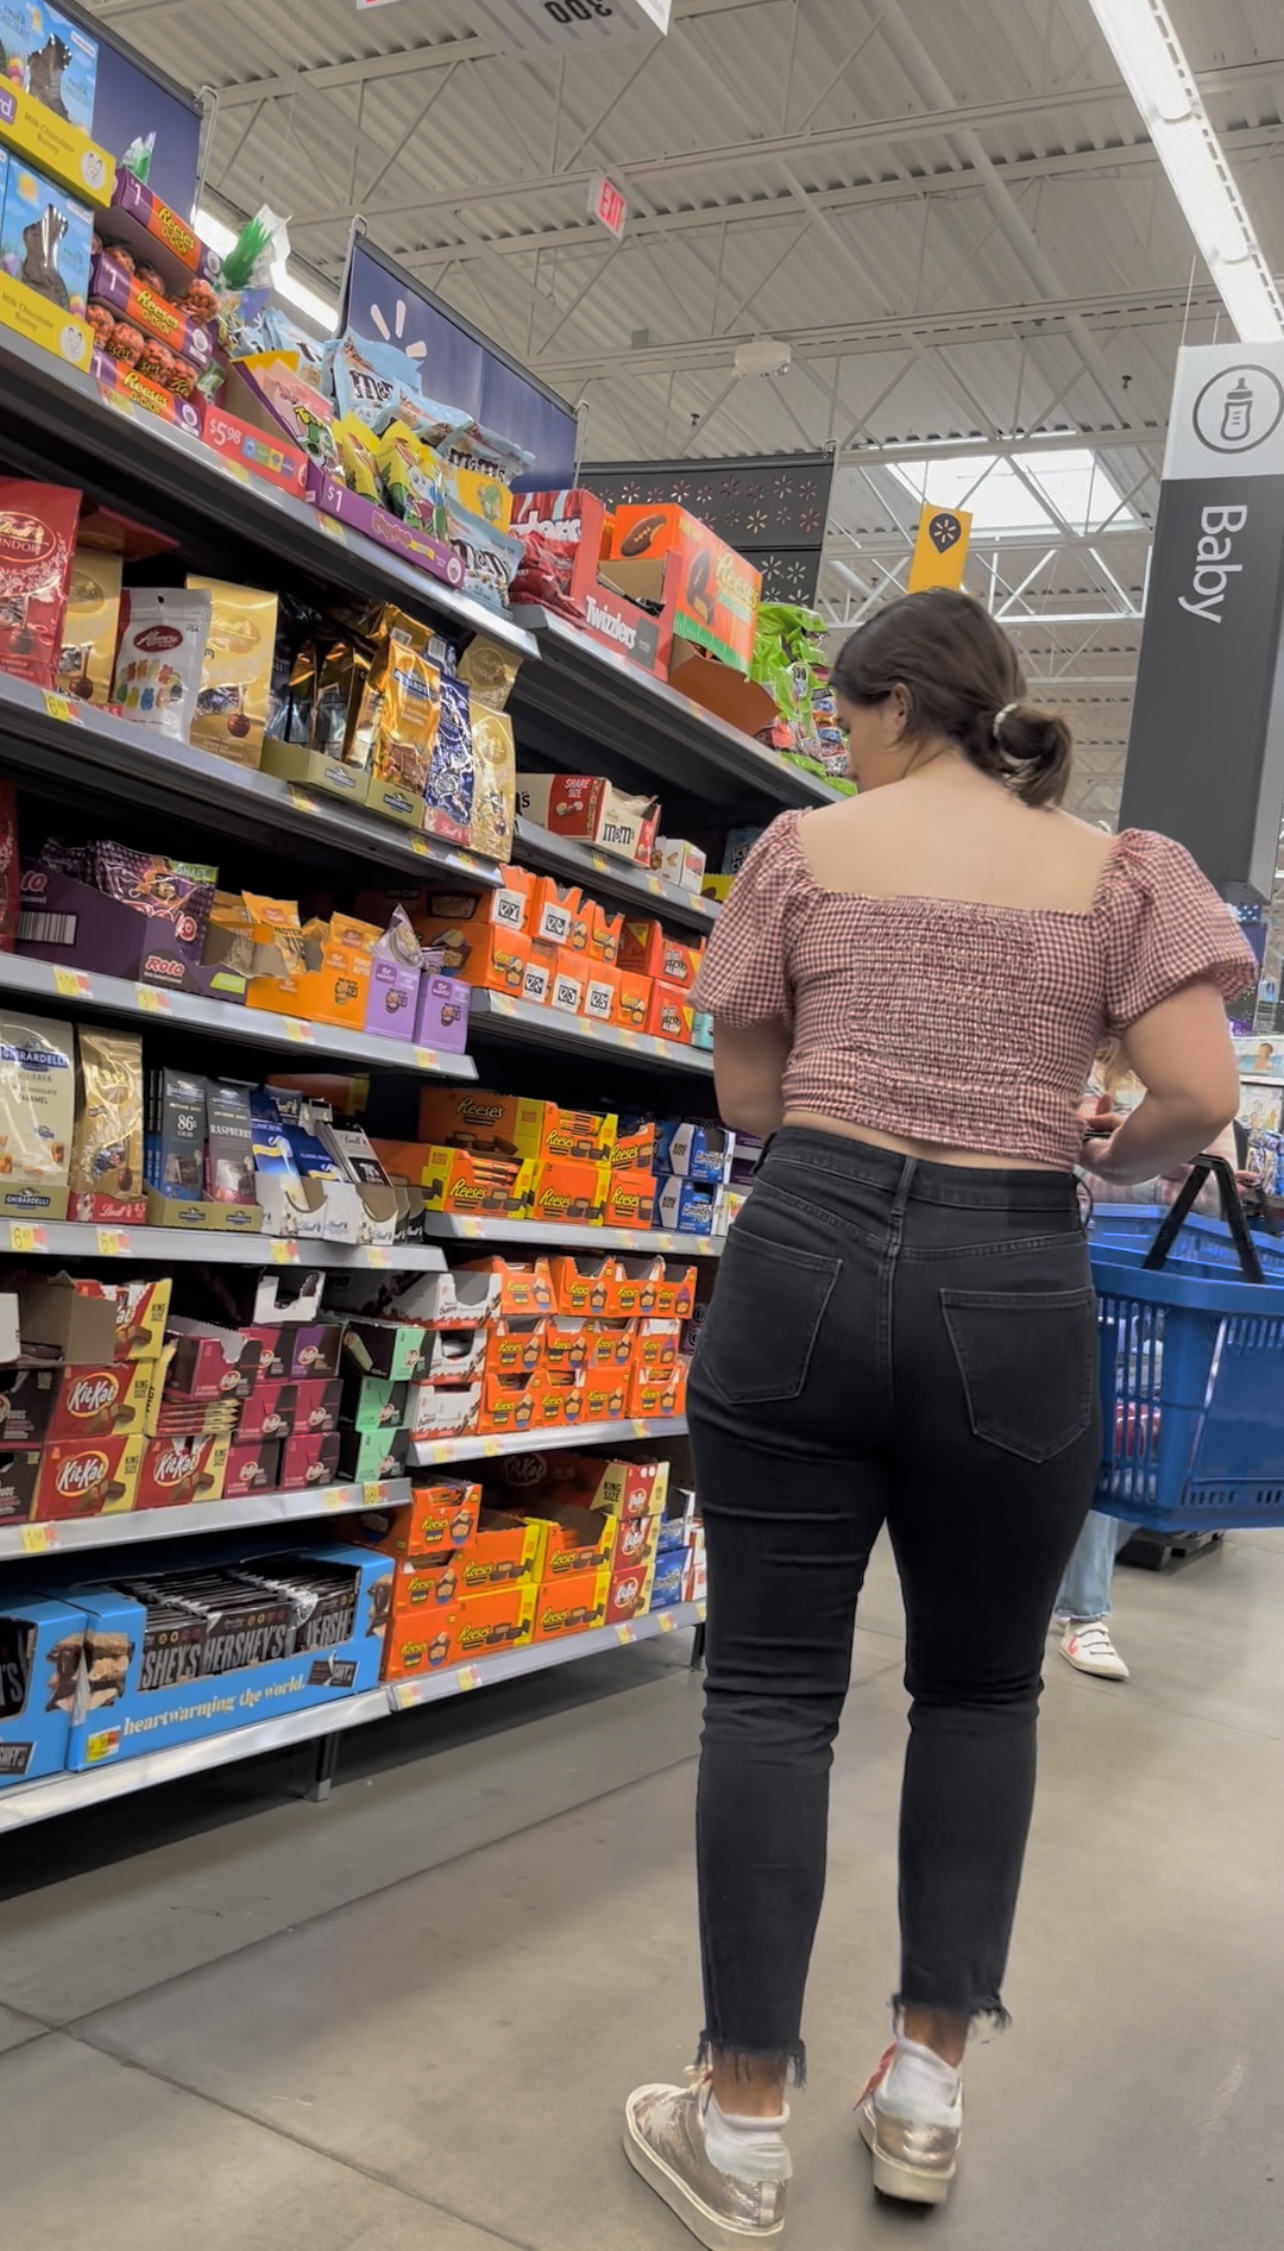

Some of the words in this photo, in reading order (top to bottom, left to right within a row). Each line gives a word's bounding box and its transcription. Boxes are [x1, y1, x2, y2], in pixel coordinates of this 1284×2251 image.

[600, 184, 624, 231] EXIT
[327, 486, 343, 512] $1
[1178, 505, 1248, 623] Baby
[585, 594, 637, 650] Twizzlers
[565, 777, 591, 789] SHARE
[568, 788, 582, 798] SIZE
[145, 955, 185, 977] Rolo
[457, 1097, 505, 1118] Reese's
[210, 1124, 252, 1139] RASPBERRY
[546, 1129, 574, 1147] Reese's
[611, 1144, 639, 1162] Reese's
[450, 1179, 487, 1200] Reese's
[539, 1188, 571, 1208] Reese's
[612, 1186, 640, 1207] Reese's
[6, 1194, 49, 1206] GHIRARDELLI
[151, 1303, 166, 1312] KING
[151, 1312, 164, 1321] SIZE
[68, 1381, 114, 1411] KitKat
[125, 1455, 139, 1464] KING
[155, 1453, 196, 1481] KitKat
[58, 1460, 105, 1491] KitKat
[124, 1464, 137, 1475] SIZE
[604, 1481, 621, 1493] KING
[603, 1491, 620, 1502] SIZE
[422, 1515, 450, 1531] Reese's
[551, 1550, 576, 1566] Reese's
[463, 1560, 493, 1578] Reese's
[407, 1577, 436, 1592] Reese's
[541, 1607, 568, 1624] Reese's
[459, 1624, 491, 1643] Reese's
[202, 1624, 287, 1674] HERSHEY'S
[142, 1644, 201, 1689] SHEY'S
[124, 1695, 237, 1736] heartwarming
[240, 1688, 262, 1708] the
[265, 1674, 306, 1694] world.
